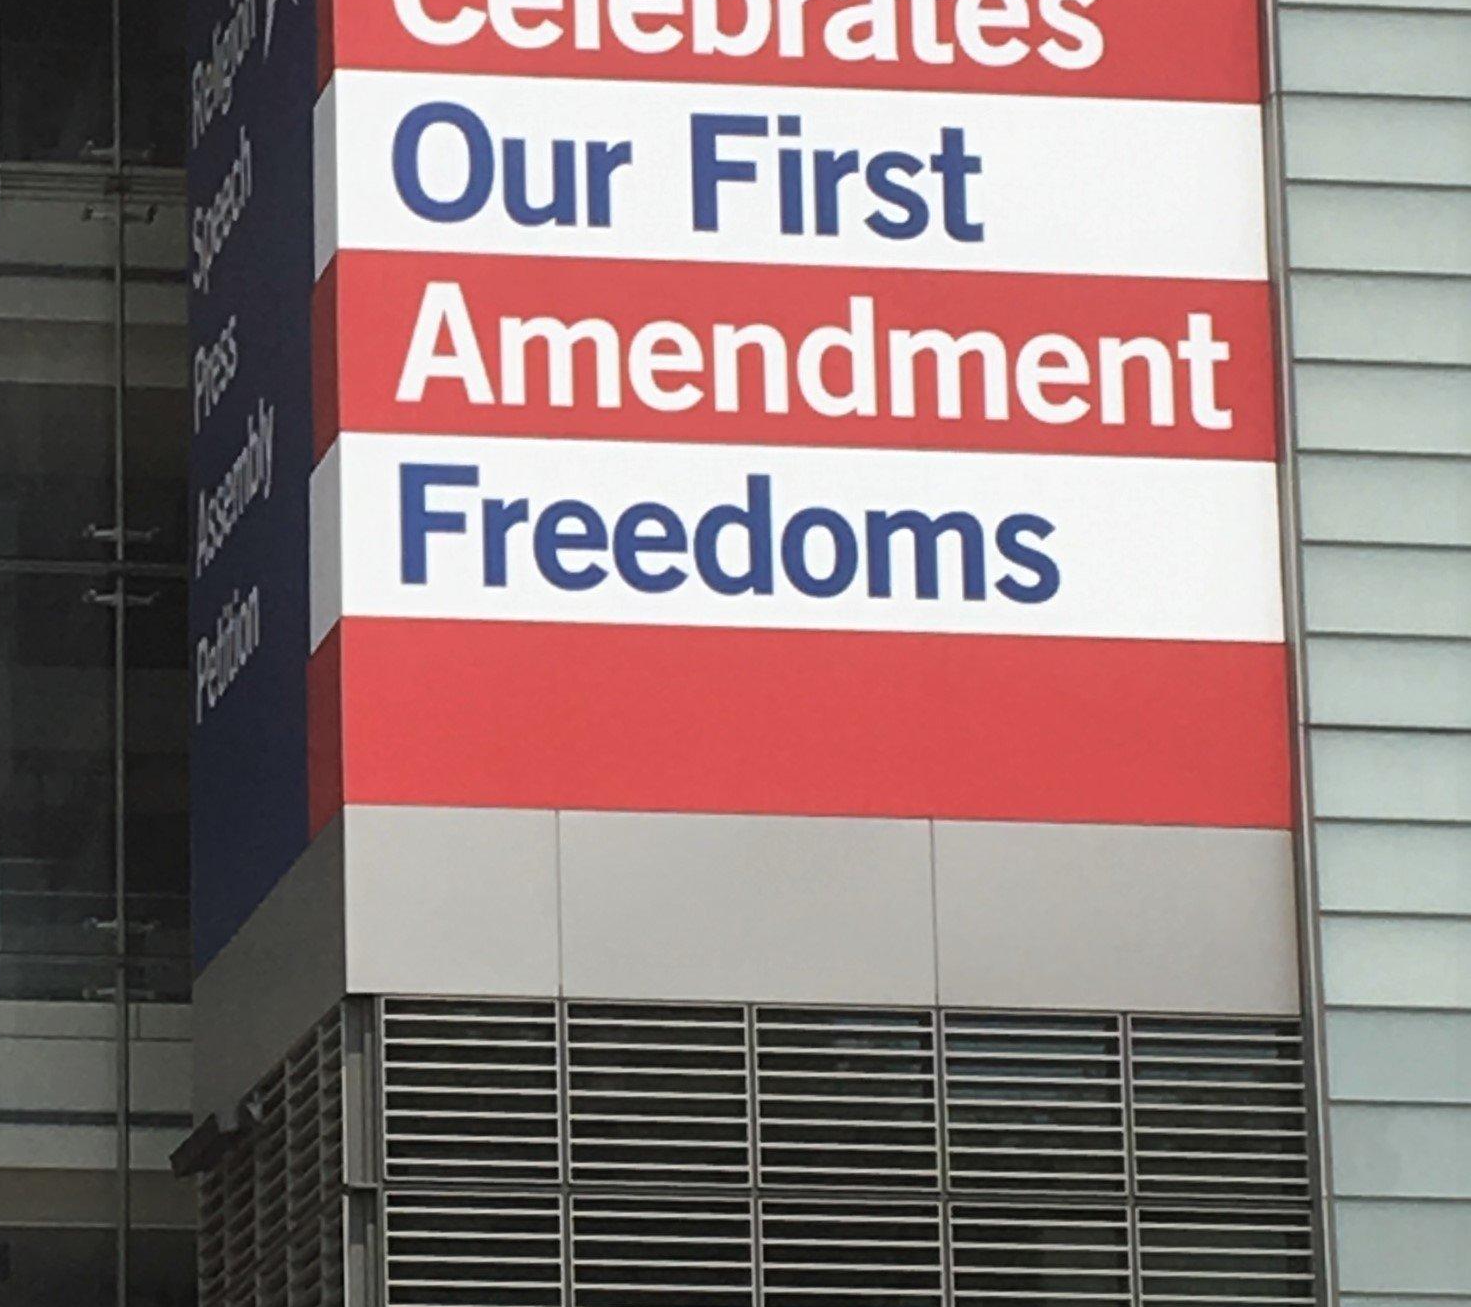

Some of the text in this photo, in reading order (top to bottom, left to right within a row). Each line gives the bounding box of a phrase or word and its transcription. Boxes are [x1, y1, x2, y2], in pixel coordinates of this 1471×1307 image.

[192, 125, 252, 294] Speech
[392, 102, 984, 242] Our First
[195, 314, 238, 434] Press
[395, 281, 1232, 430] Amendment
[197, 398, 274, 579] Assembly
[399, 463, 1061, 604] Freedoms
[197, 586, 259, 724] Petition
